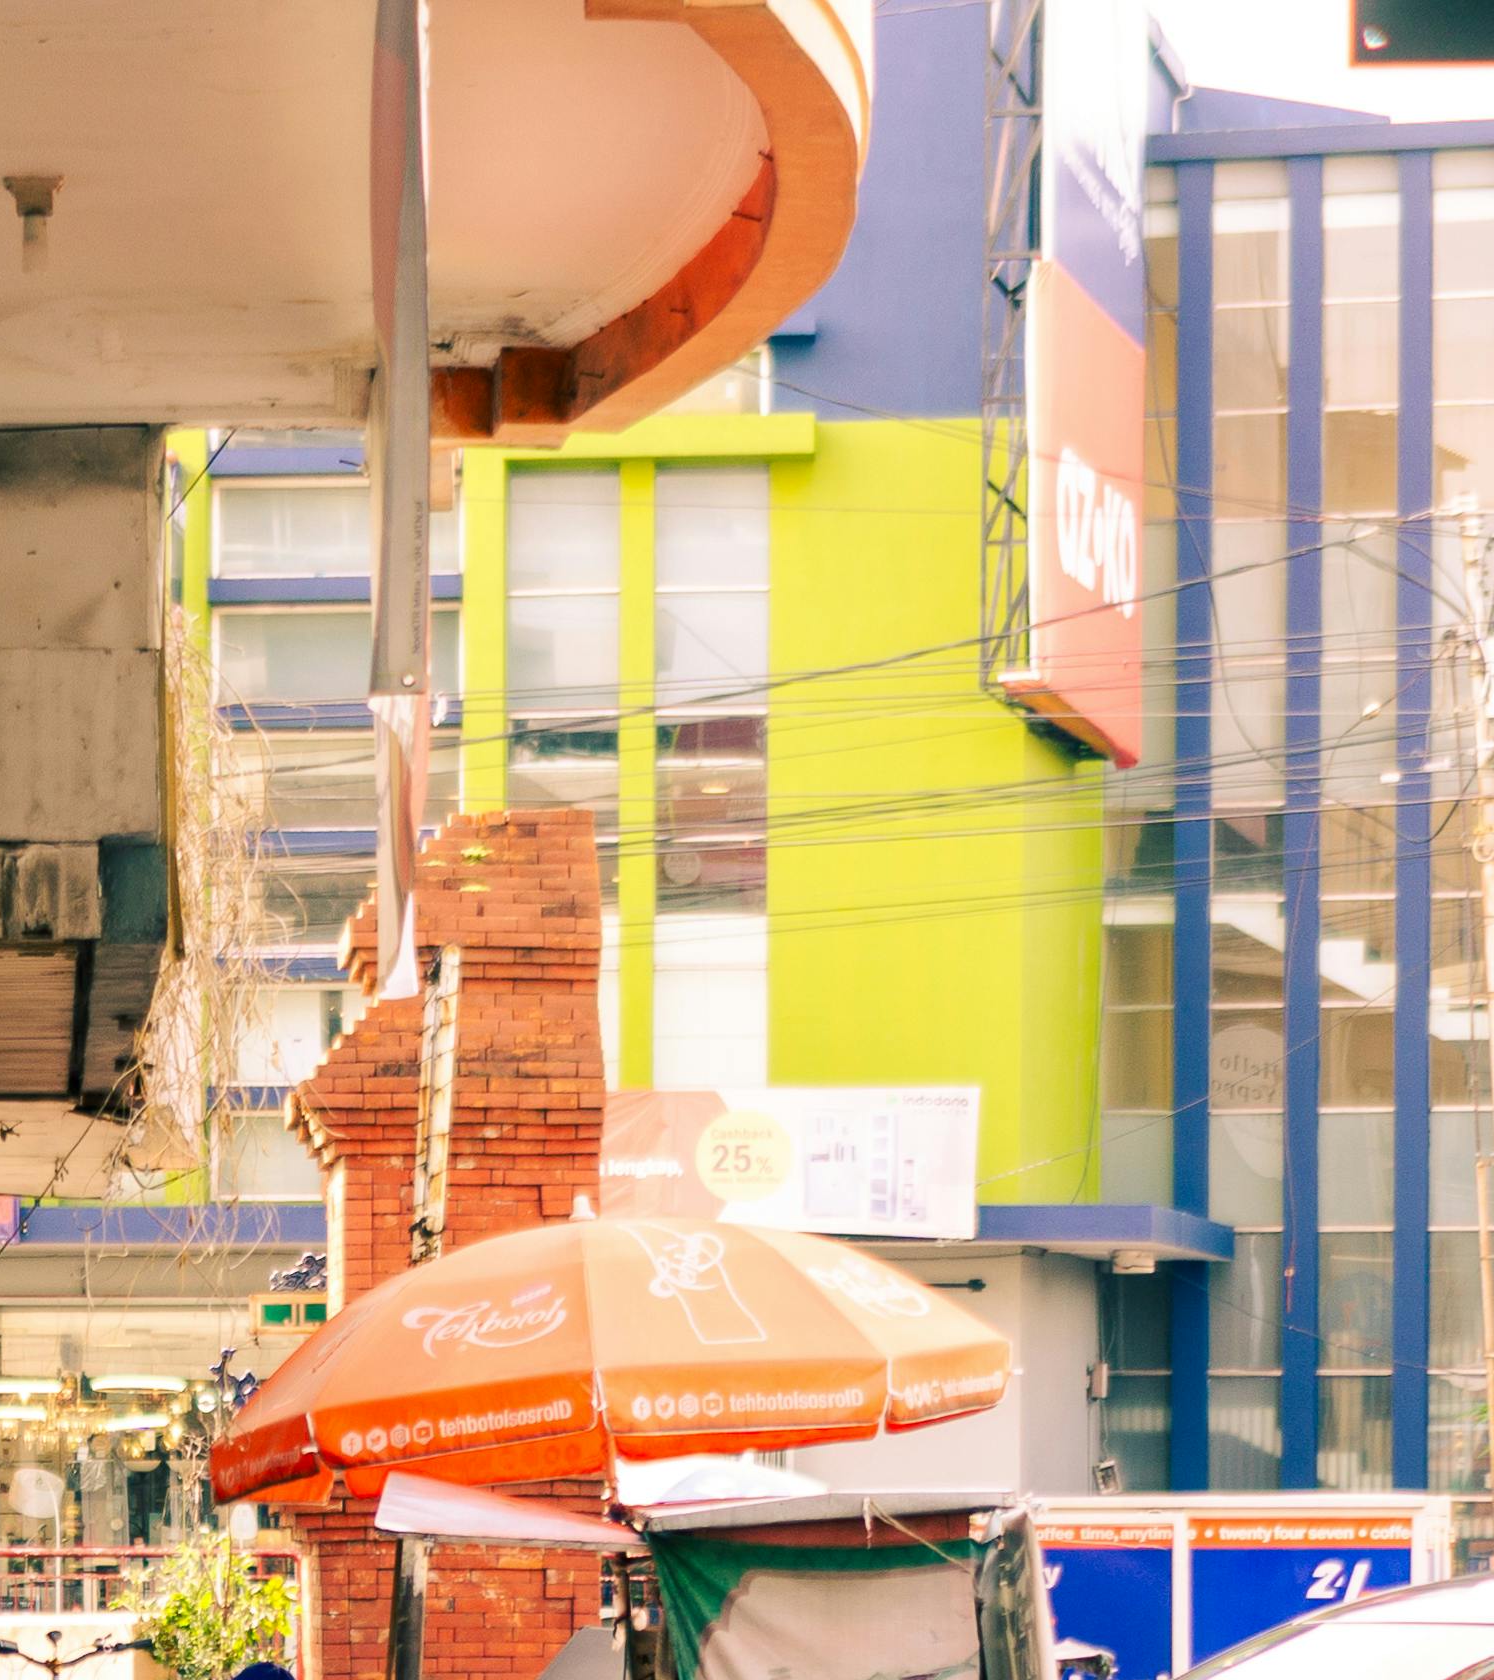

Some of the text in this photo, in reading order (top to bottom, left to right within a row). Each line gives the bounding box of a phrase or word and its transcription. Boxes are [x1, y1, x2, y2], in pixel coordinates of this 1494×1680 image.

[1037, 1528, 1075, 1541] offee
[1219, 1526, 1272, 1542] twenty
[1274, 1525, 1307, 1540] four
[1308, 1527, 1354, 1540] seven
